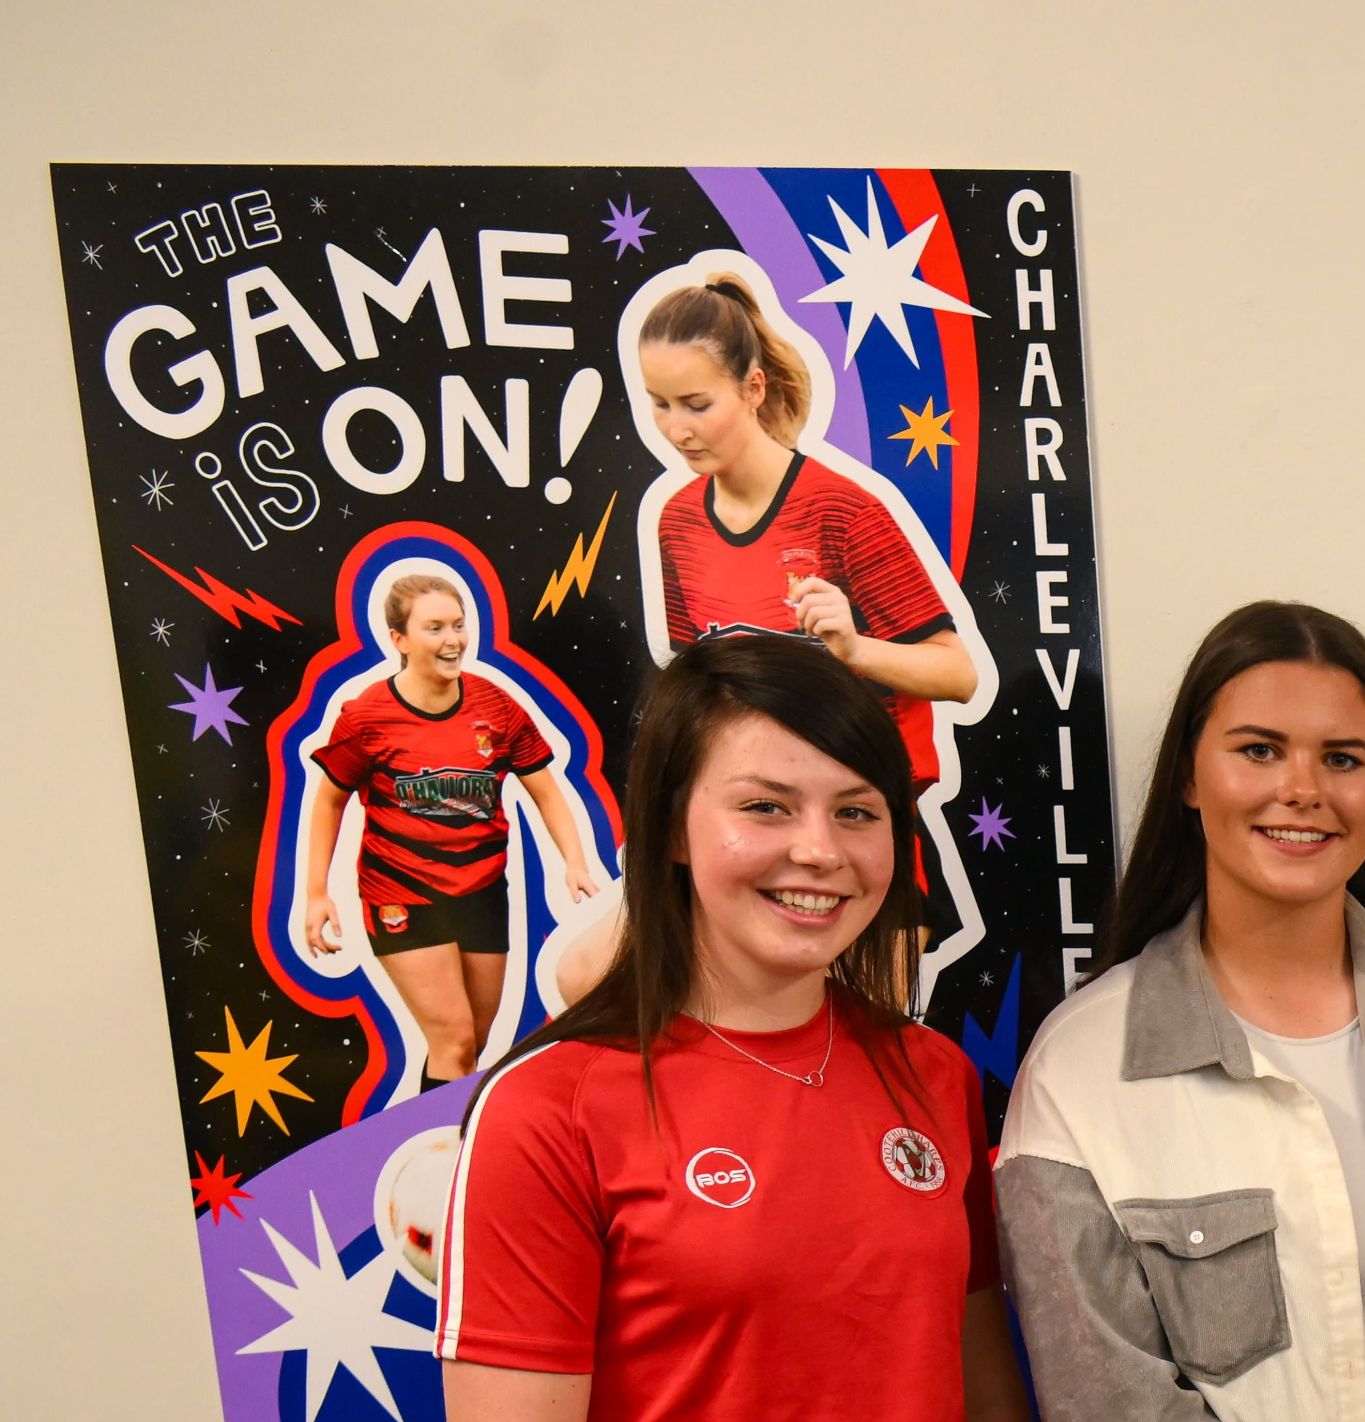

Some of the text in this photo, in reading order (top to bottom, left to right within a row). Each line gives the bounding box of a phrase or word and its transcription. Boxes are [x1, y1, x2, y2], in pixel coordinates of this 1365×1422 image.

[135, 190, 282, 277] THE
[105, 227, 574, 439] GAME
[321, 368, 603, 505] ON!
[1007, 189, 1094, 997] CHARLEVILLE
[696, 1169, 747, 1188] BOS
